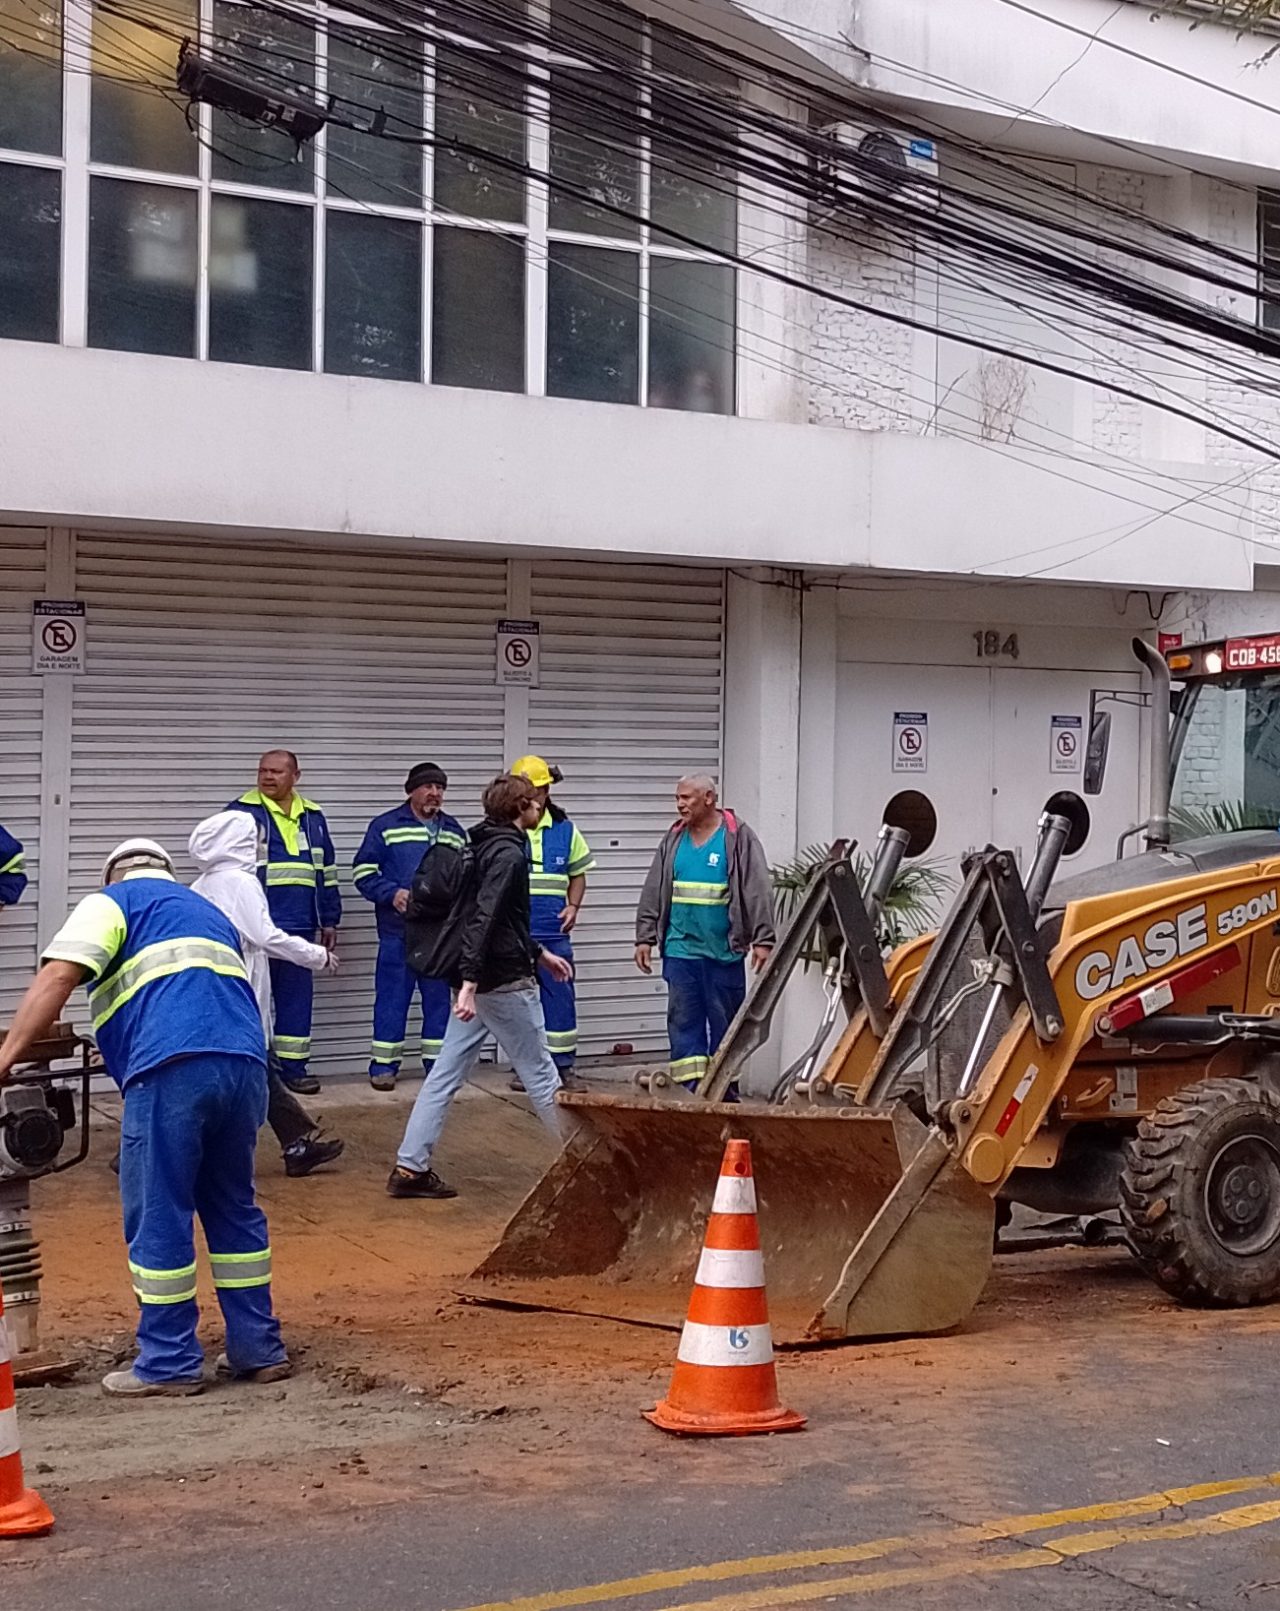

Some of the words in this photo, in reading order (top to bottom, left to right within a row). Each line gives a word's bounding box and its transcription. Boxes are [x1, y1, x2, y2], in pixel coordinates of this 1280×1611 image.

[973, 630, 1020, 660] 184
[1074, 902, 1209, 1000] CASE
[1216, 888, 1278, 936] 580N
